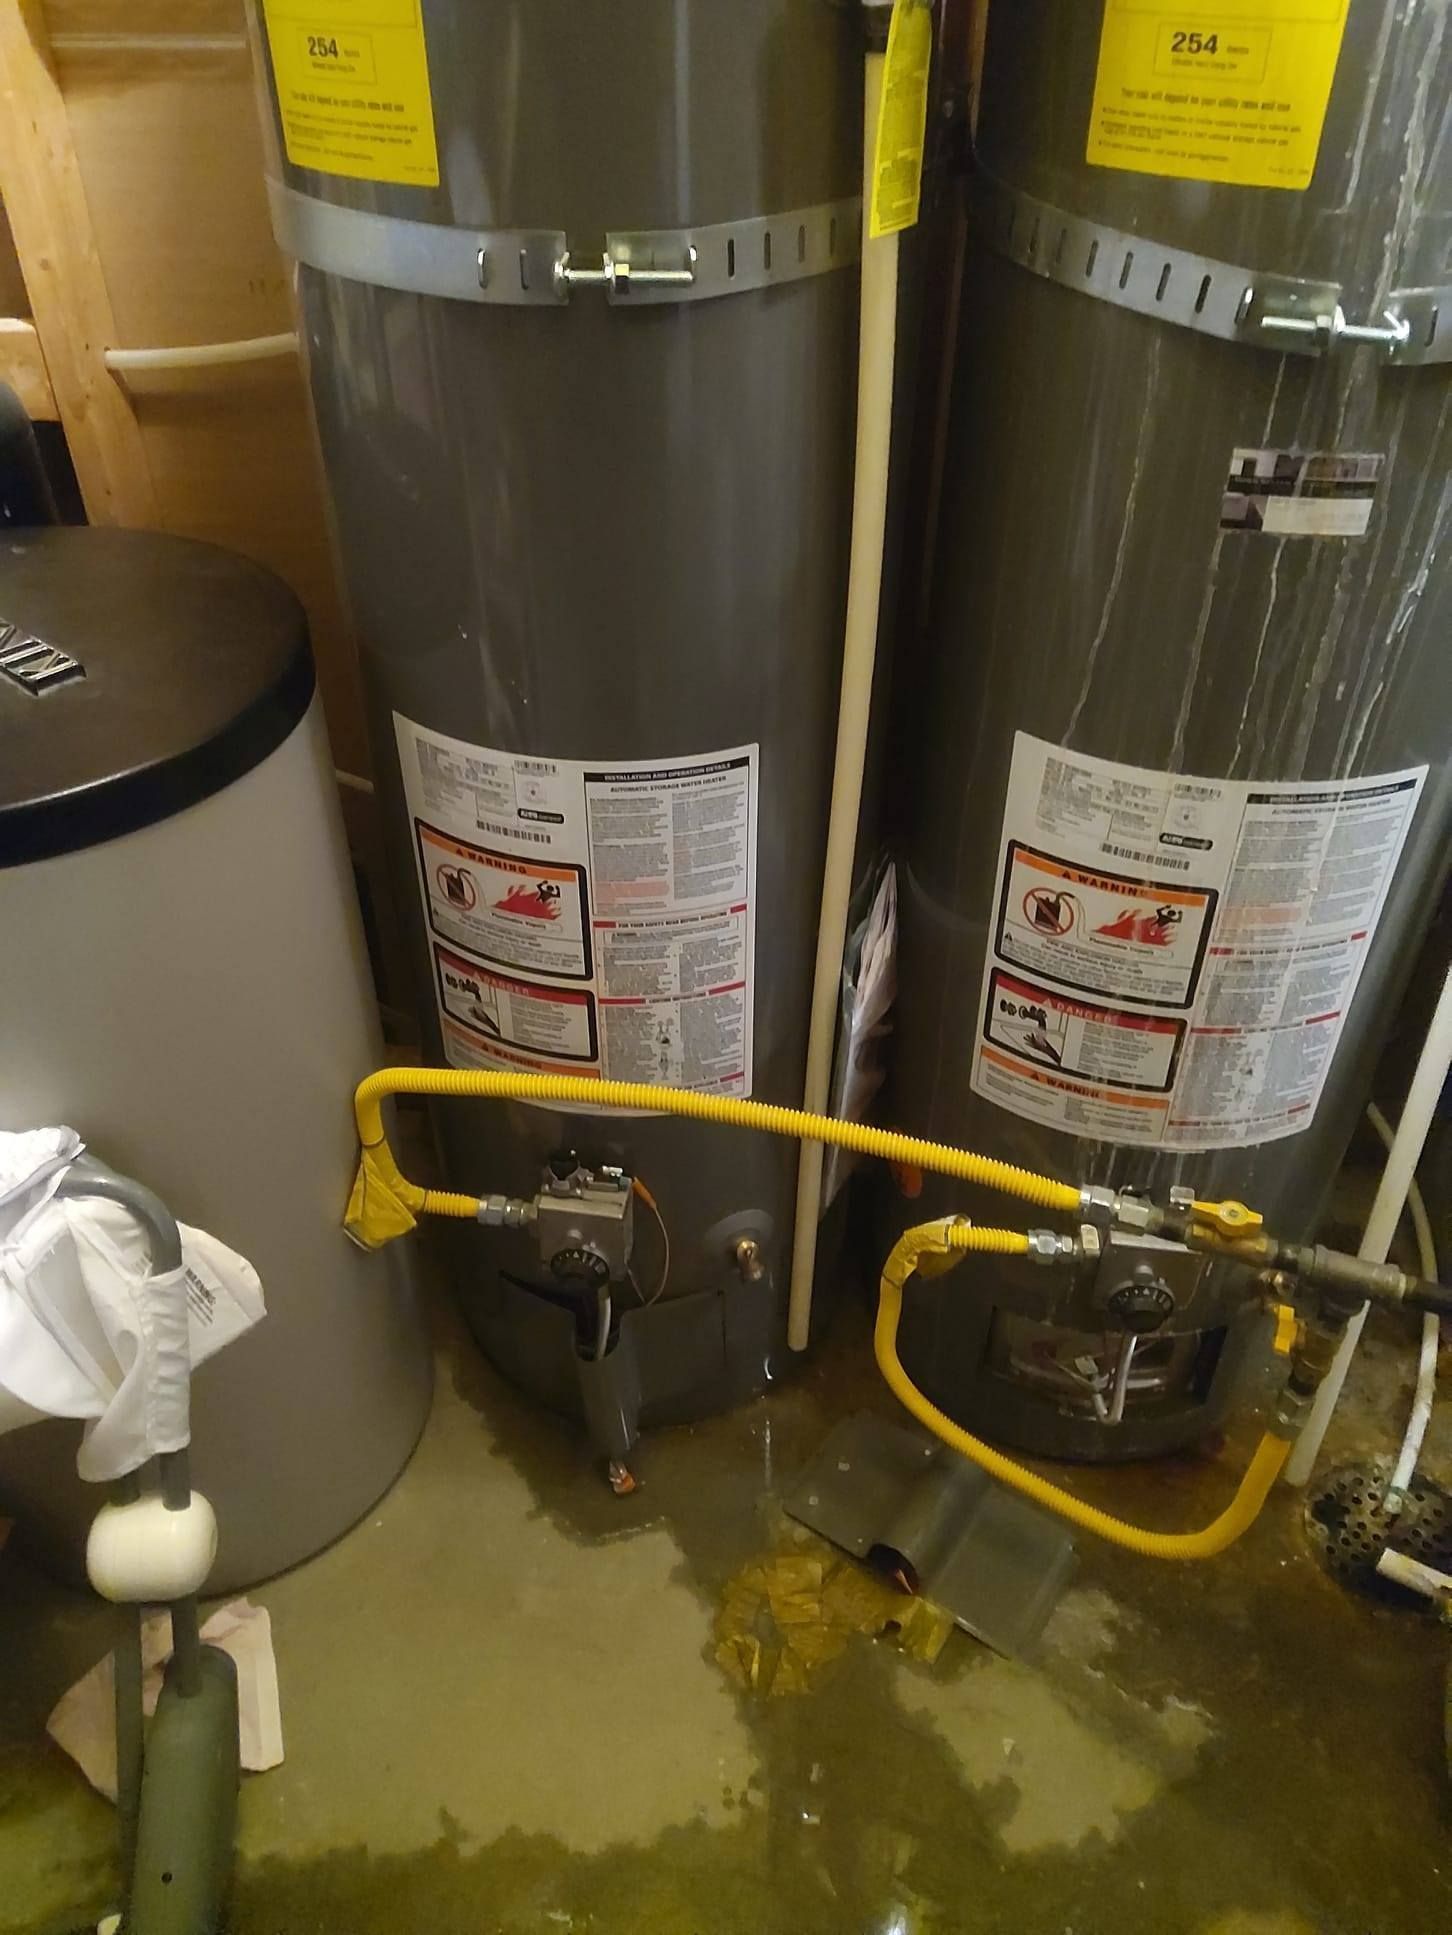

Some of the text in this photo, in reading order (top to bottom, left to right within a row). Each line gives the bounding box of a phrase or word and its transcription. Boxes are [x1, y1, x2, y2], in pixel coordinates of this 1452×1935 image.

[307, 36, 339, 58] 254
[1171, 31, 1218, 54] 254
[467, 853, 527, 874] WARNING
[481, 975, 529, 995] DANGER
[1056, 1002, 1113, 1024] DANGER
[492, 1046, 542, 1069] WARNING
